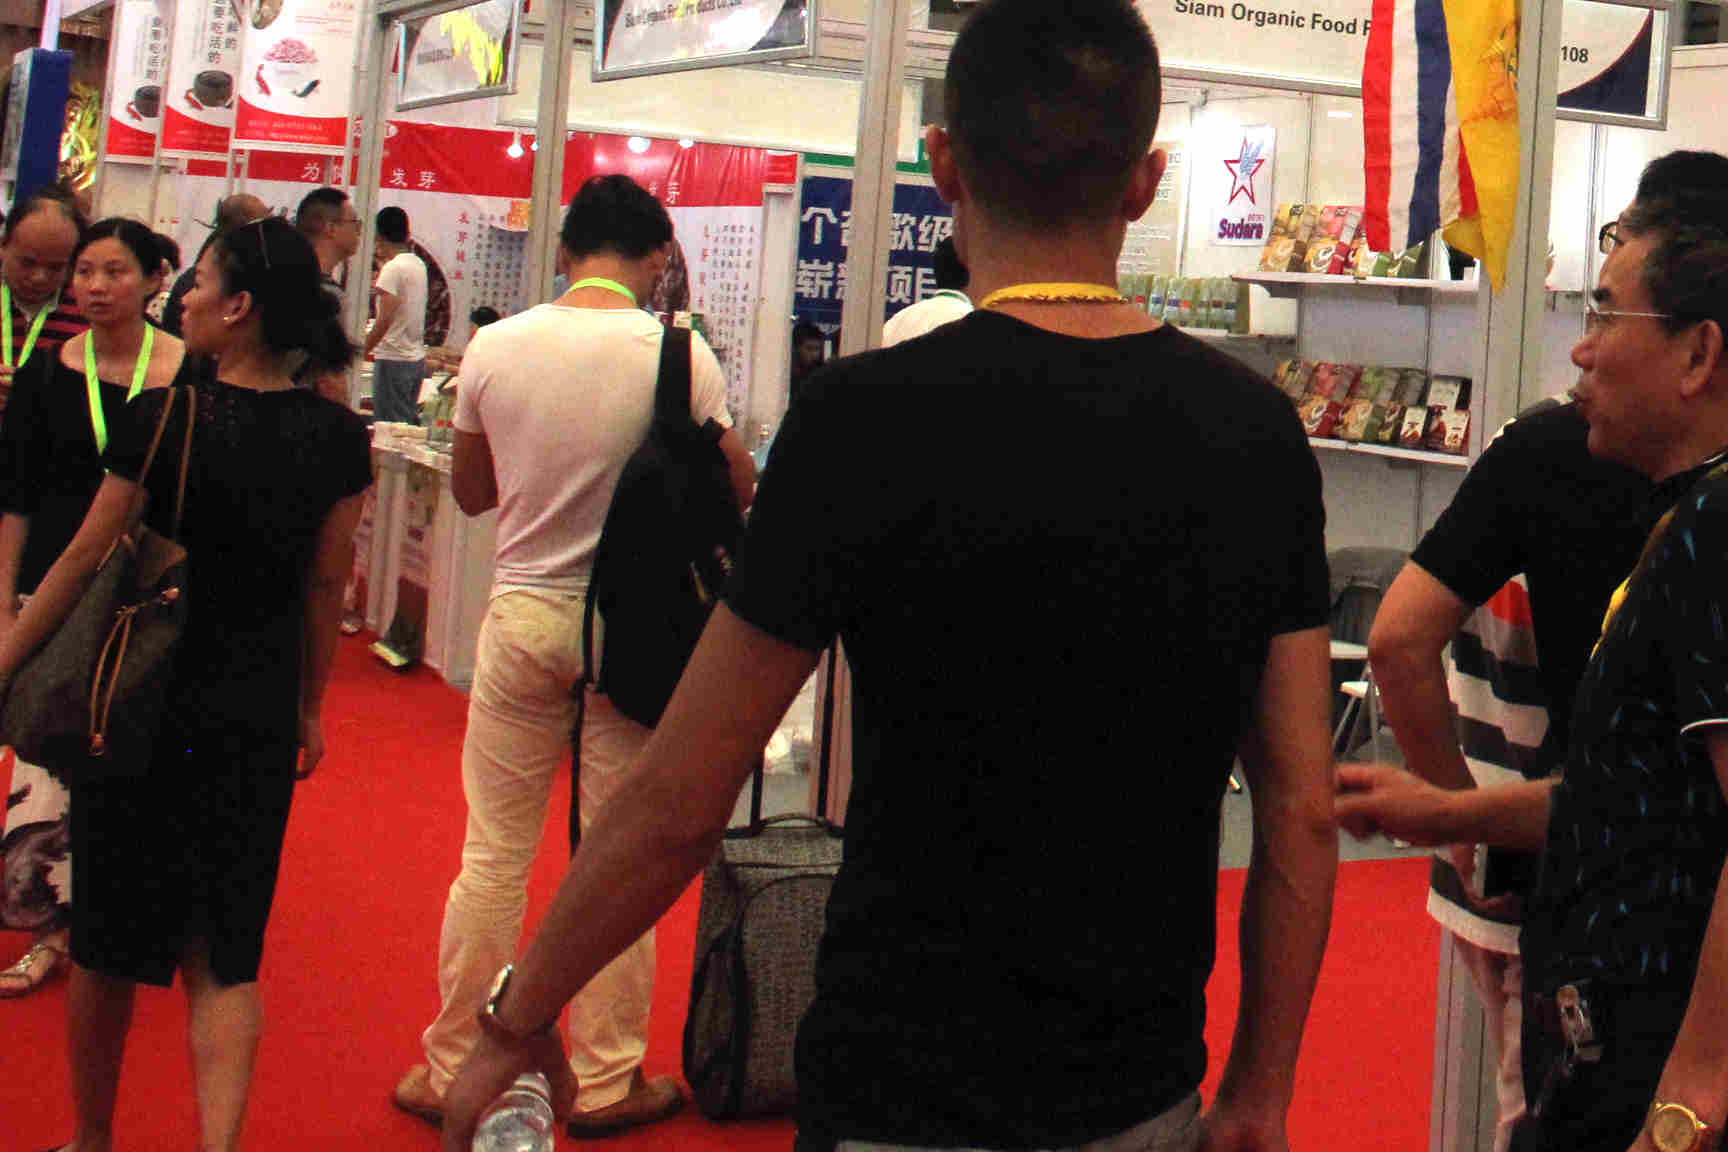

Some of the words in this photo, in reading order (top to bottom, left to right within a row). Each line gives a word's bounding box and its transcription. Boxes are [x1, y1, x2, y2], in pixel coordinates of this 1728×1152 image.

[1231, 2, 1305, 28] Organic
[1311, 12, 1357, 35] Food
[1560, 45, 1589, 64] 108
